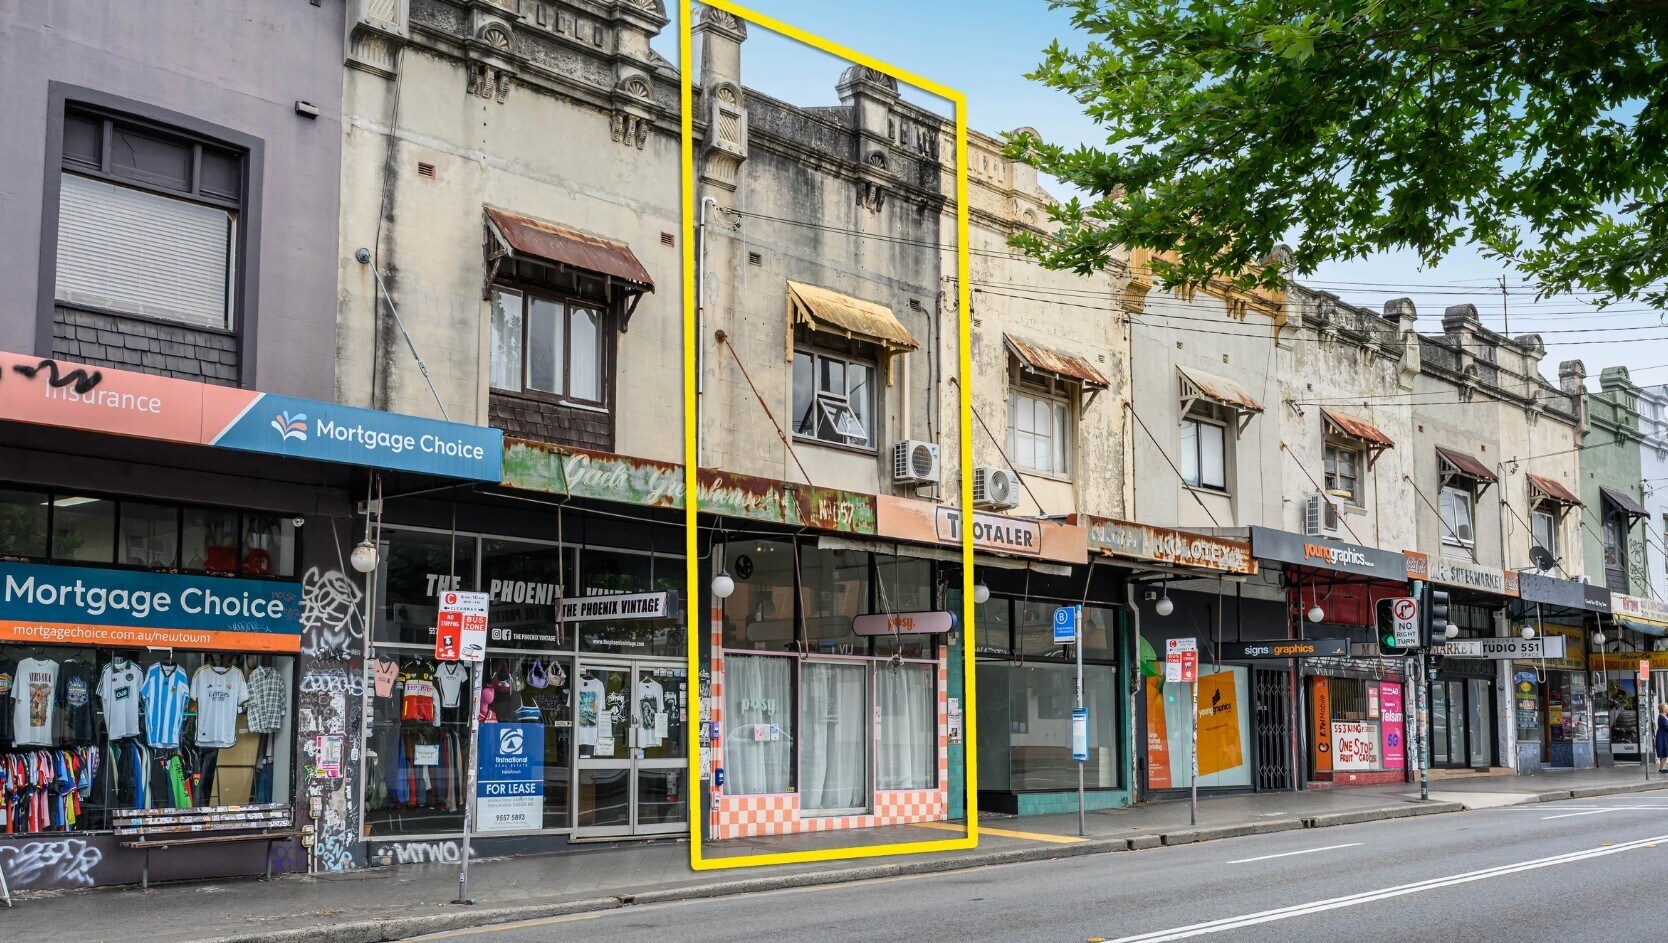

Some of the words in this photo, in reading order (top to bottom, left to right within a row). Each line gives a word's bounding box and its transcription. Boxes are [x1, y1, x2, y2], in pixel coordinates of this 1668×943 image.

[45, 377, 161, 413] Insurance
[316, 418, 416, 453] Mortgage
[419, 434, 484, 460] Choice
[426, 573, 461, 598] THE
[5, 574, 172, 618] Mortgage
[180, 587, 285, 618] Choice
[562, 603, 577, 617] THE
[581, 601, 618, 616] PHOENIX
[621, 598, 660, 614] VINTAGE
[1398, 622, 1413, 631] NO
[1244, 645, 1269, 656] signs
[1273, 643, 1315, 656] graphics
[1482, 644, 1517, 653] TUDIO
[1520, 643, 1540, 652] 551
[741, 698, 776, 716] posy
[1334, 724, 1347, 733] 553
[1339, 737, 1353, 753] ONE
[1354, 737, 1374, 755] STOP
[1387, 734, 1399, 747] 5G
[1340, 754, 1353, 763] FRUIT
[486, 784, 506, 795] FOR
[508, 783, 536, 794] LEASE
[495, 814, 510, 822] 9557
